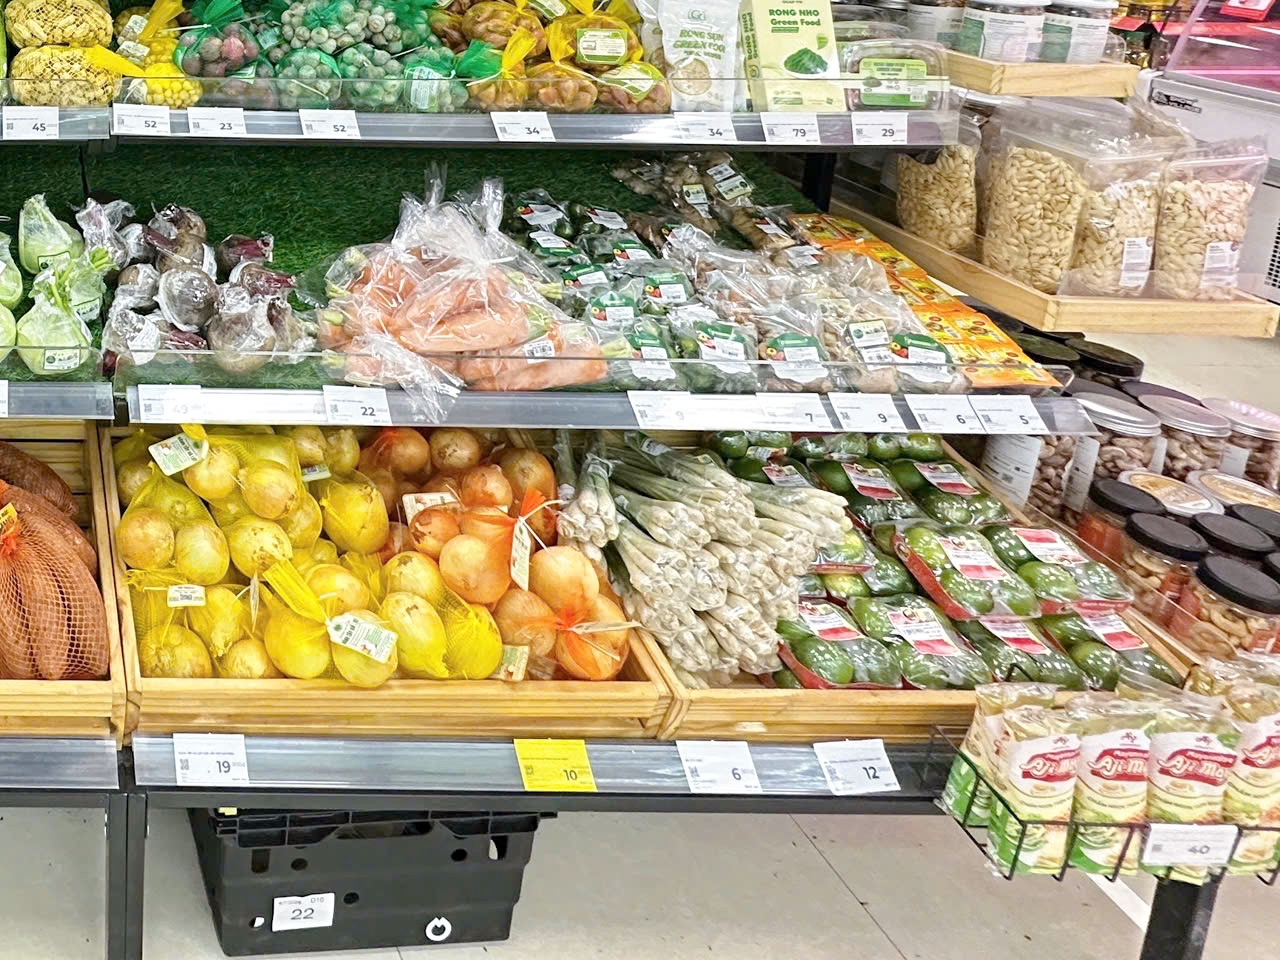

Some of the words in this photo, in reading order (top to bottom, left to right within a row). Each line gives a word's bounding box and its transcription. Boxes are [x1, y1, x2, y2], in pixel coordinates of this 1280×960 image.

[769, 9, 797, 17] RONG
[799, 9, 820, 17] NHO
[32, 123, 46, 132] 45
[144, 120, 157, 129] 52
[220, 123, 233, 131] 23
[333, 124, 346, 133] 52
[525, 126, 539, 135] 34
[792, 128, 806, 137] 79
[881, 128, 895, 137] 29
[361, 407, 376, 417] 22
[805, 412, 813, 422] 7
[878, 413, 887, 423] 9
[957, 414, 965, 424] 6
[1021, 415, 1029, 425] 5
[216, 760, 232, 774] 19
[563, 768, 578, 782] 10
[731, 767, 741, 780] 6
[862, 766, 879, 780] 12
[1188, 844, 1210, 855] 40
[291, 908, 315, 921] 22
